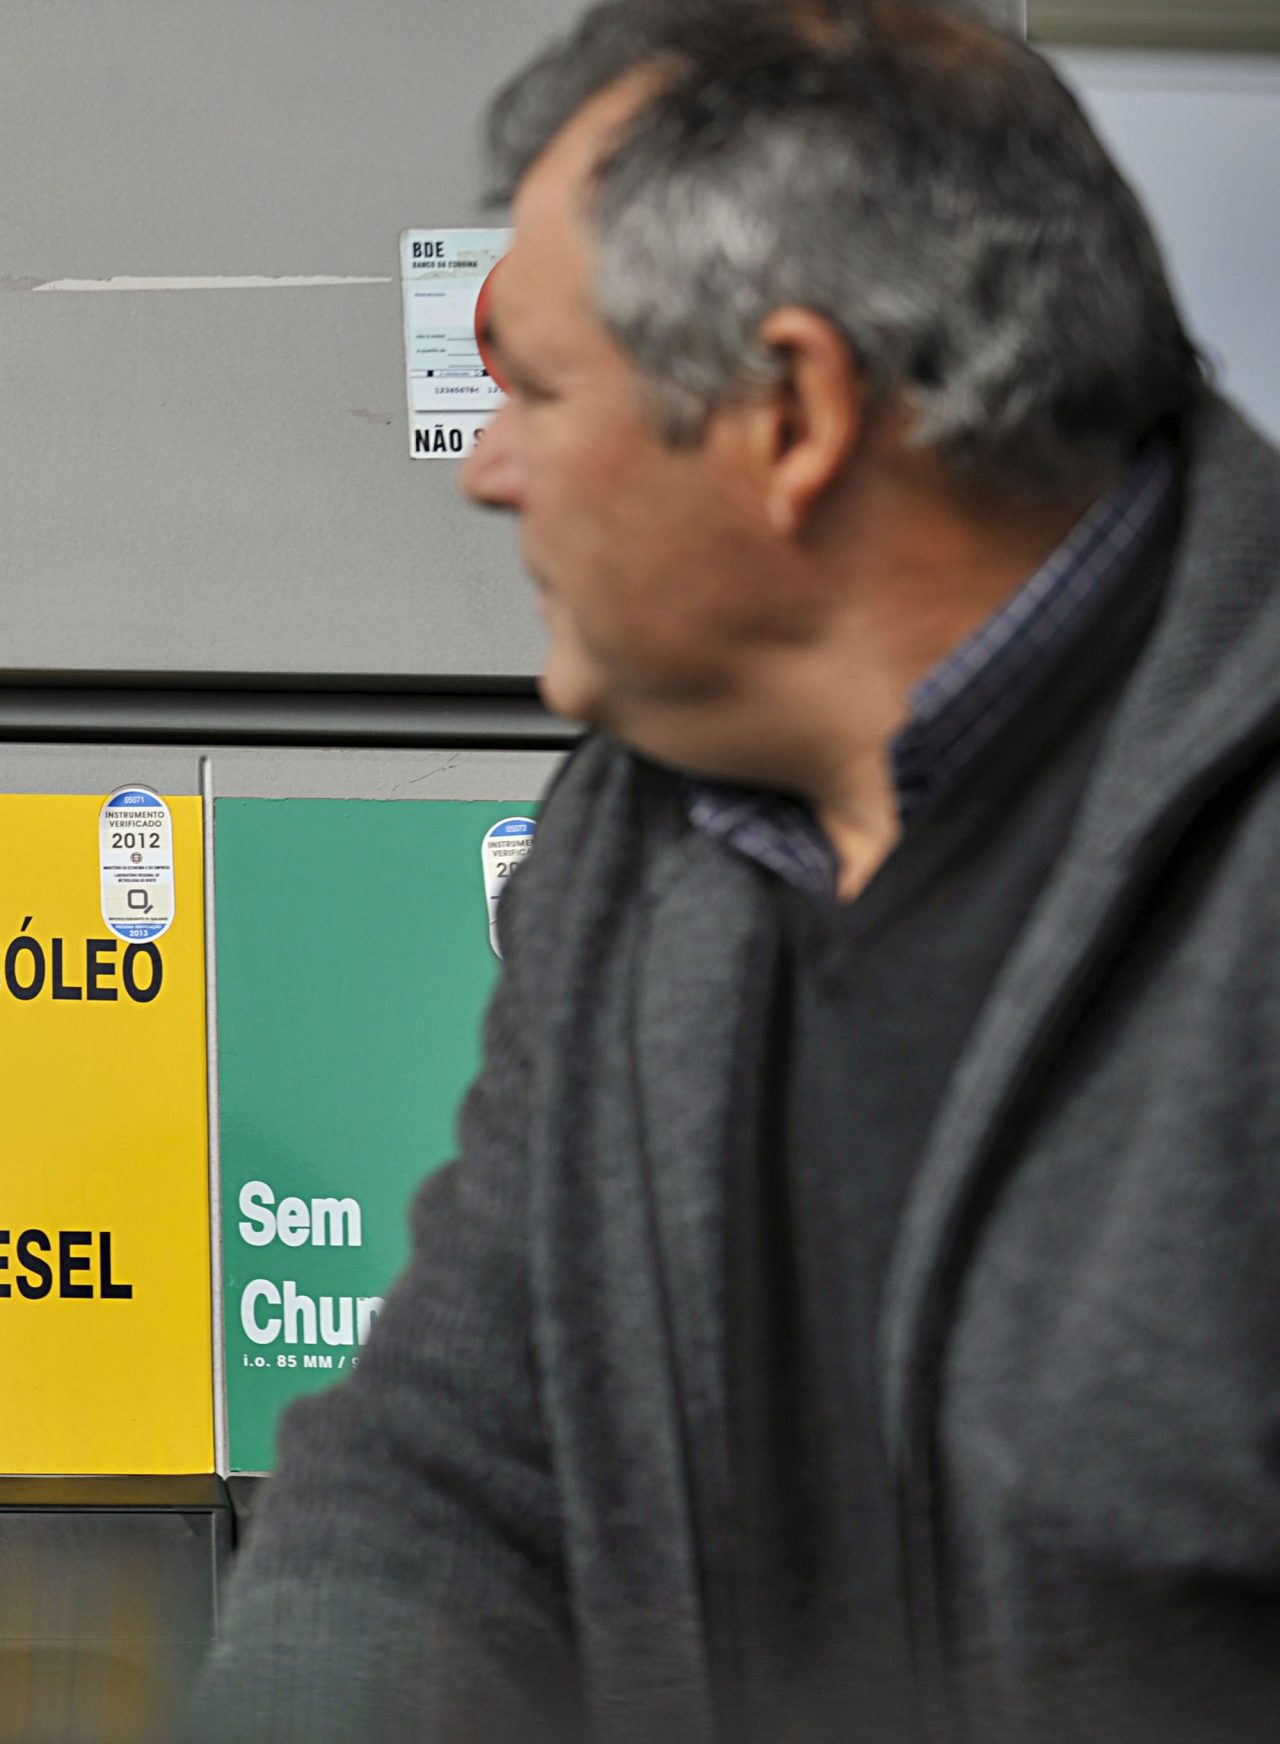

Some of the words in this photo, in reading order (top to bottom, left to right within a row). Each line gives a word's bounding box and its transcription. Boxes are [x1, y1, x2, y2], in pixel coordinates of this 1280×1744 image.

[413, 241, 445, 258] BDE
[414, 424, 463, 452] NÃO
[112, 832, 160, 848] 2012
[238, 1180, 362, 1247] Sem
[243, 1354, 271, 1367] i.o.
[277, 1355, 297, 1367] 85
[303, 1355, 333, 1368] MM
